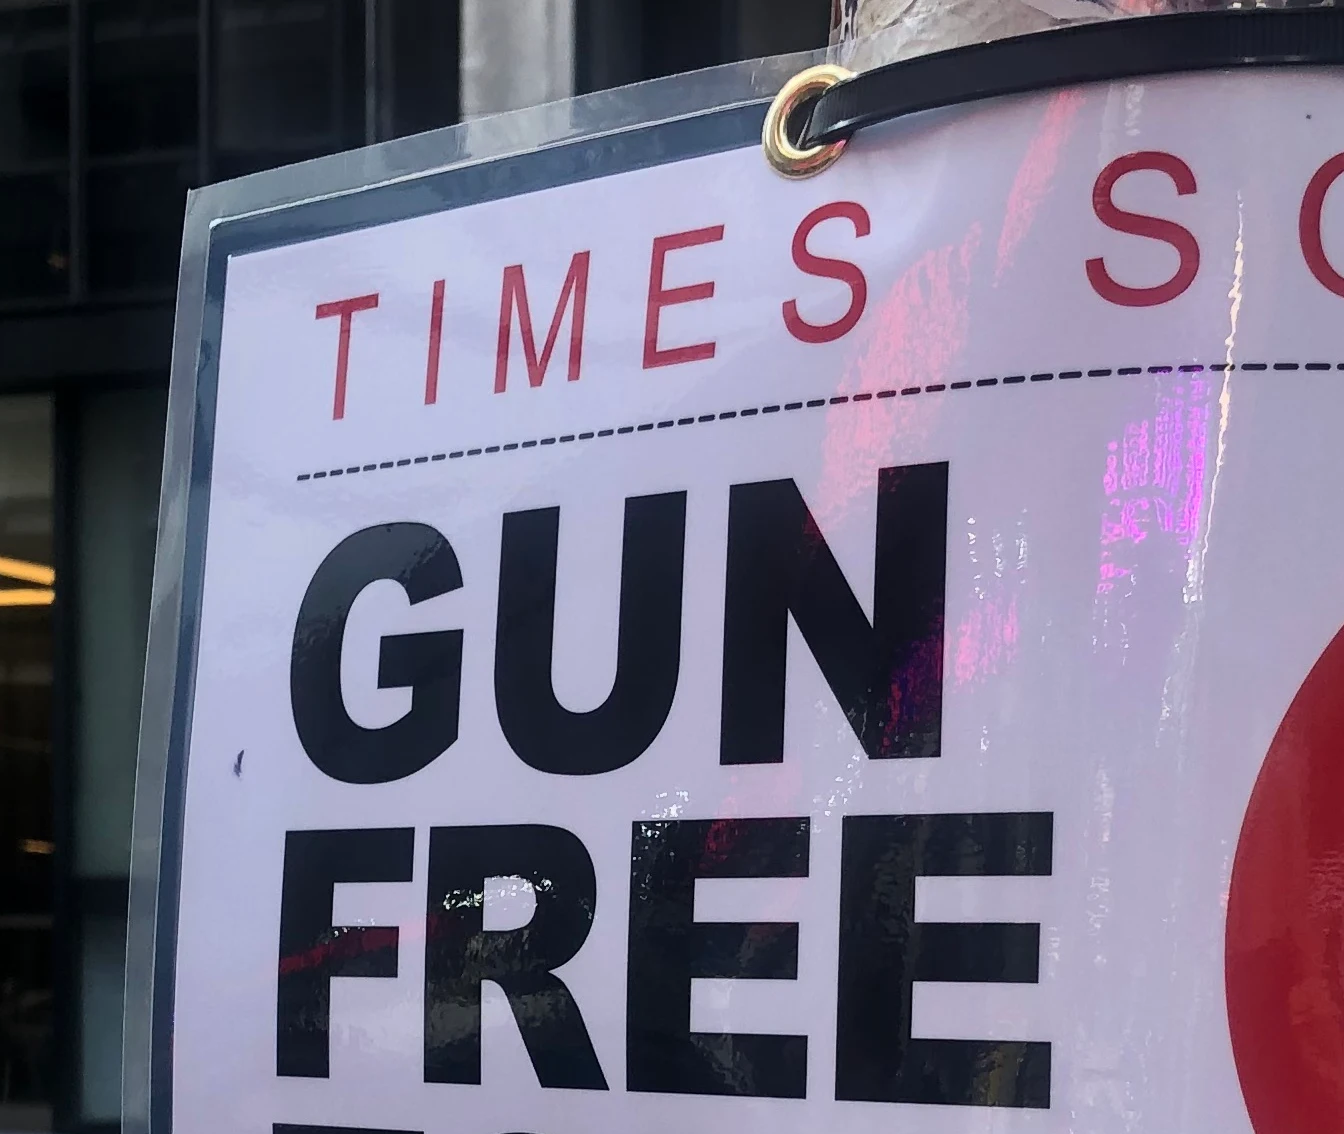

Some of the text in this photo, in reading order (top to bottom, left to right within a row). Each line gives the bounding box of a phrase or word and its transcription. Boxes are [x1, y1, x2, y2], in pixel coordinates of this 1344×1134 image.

[315, 200, 871, 420] TIMES
[290, 460, 950, 785] GUN
[277, 811, 1054, 1109] FREE
